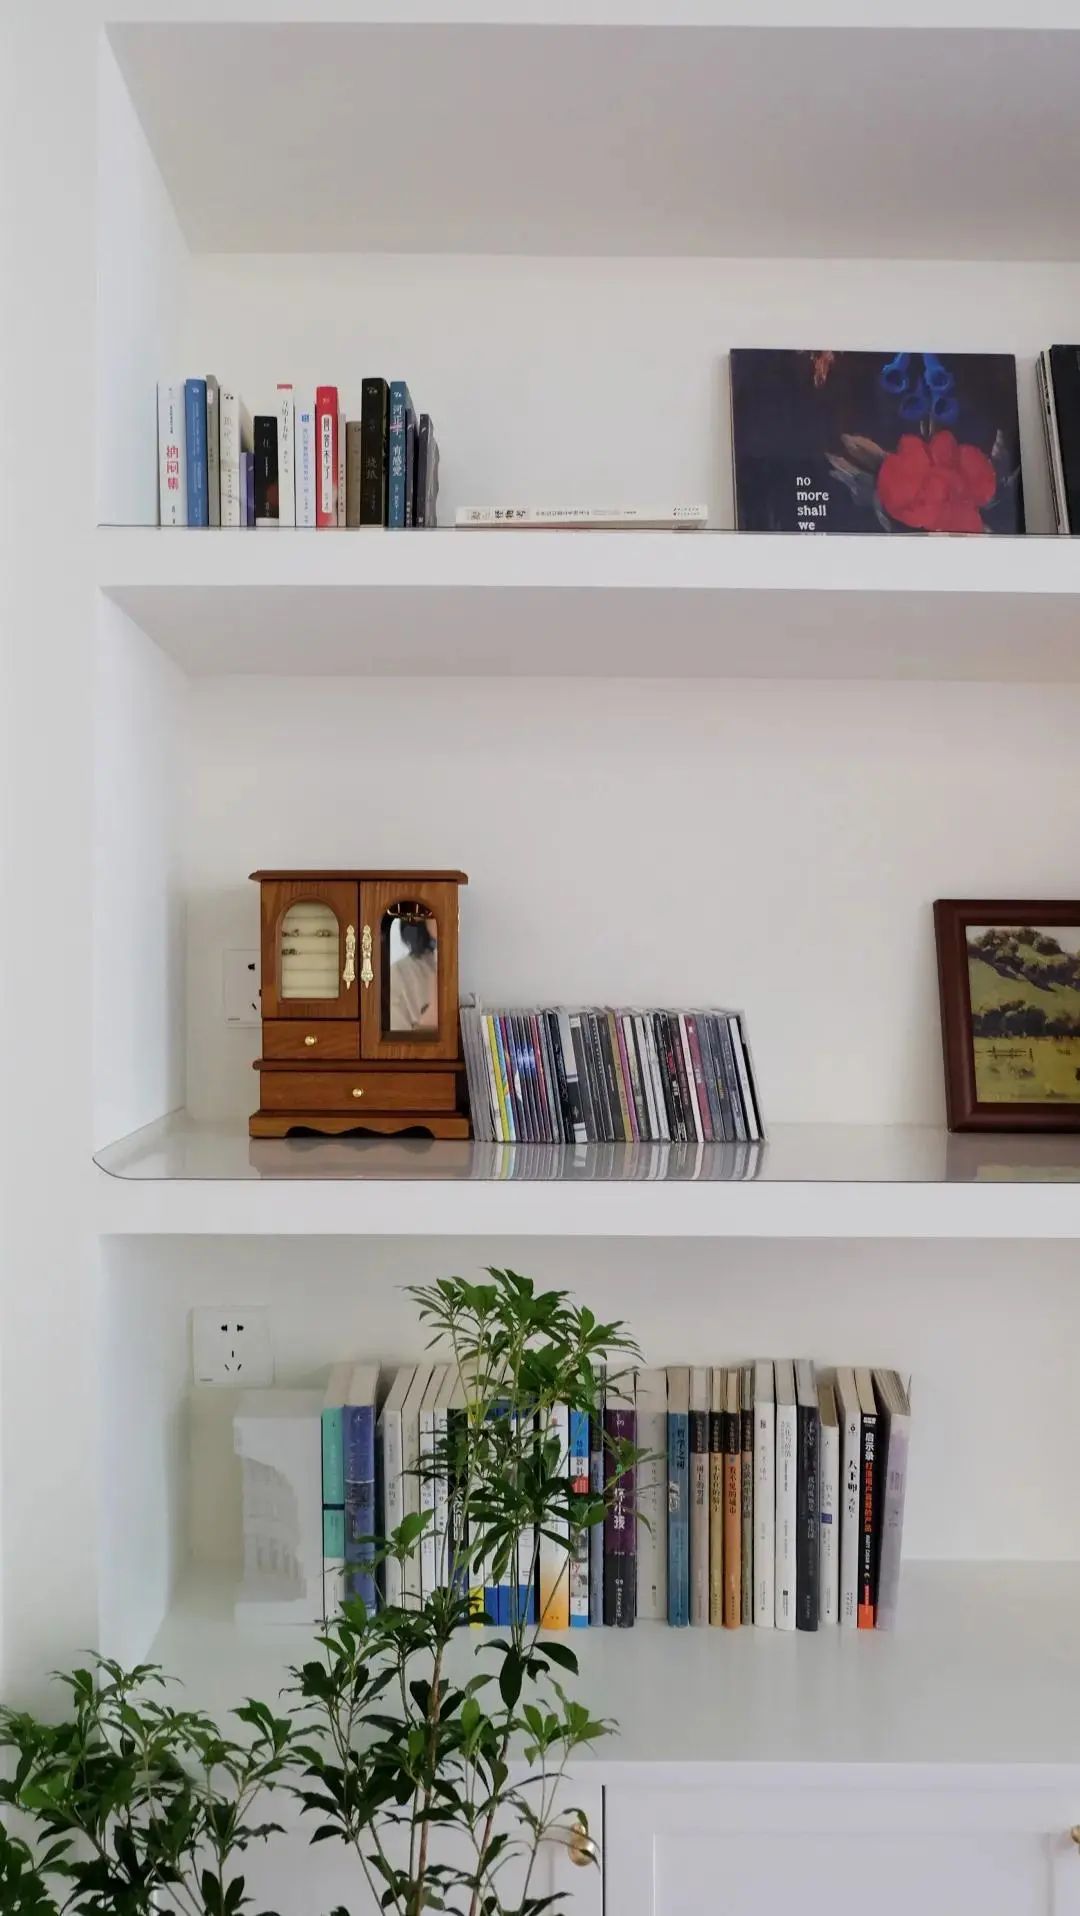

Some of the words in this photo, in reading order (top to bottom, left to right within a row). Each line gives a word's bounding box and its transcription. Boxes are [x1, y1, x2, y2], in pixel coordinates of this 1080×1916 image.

[796, 476, 811, 486] no
[796, 491, 829, 501] more
[797, 504, 827, 516] shall
[798, 521, 816, 531] we
[865, 1432, 875, 1461] 启示录
